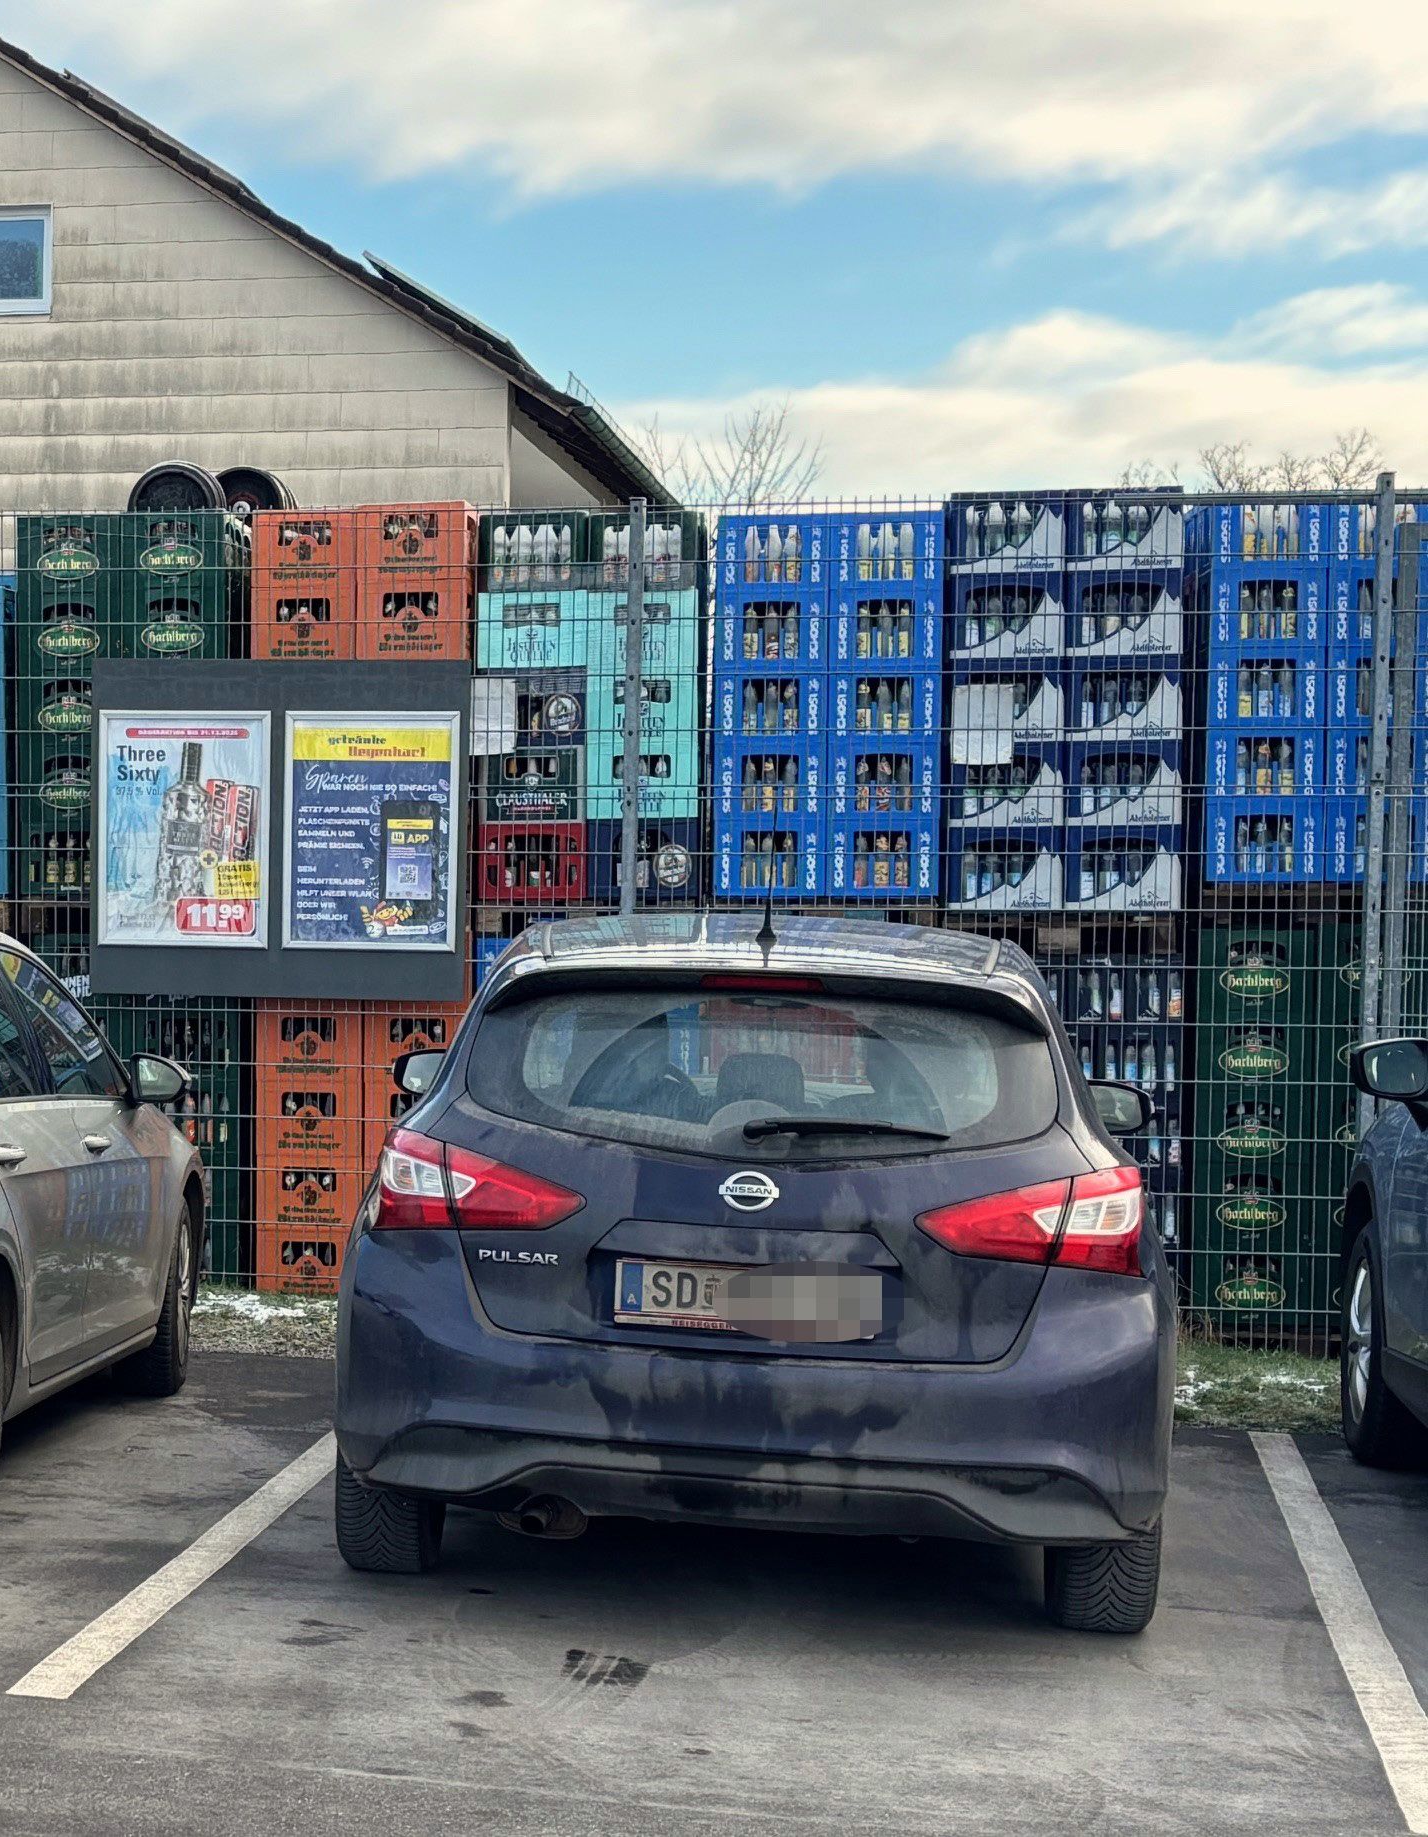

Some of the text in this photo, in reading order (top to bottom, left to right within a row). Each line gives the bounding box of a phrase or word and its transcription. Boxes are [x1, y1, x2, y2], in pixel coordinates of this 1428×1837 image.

[116, 745, 166, 762] Three
[117, 764, 160, 785] Sixty
[305, 764, 367, 794] Sparen
[135, 786, 143, 796] %
[146, 786, 162, 796] Vol.
[399, 784, 437, 792] EINFACH!
[496, 791, 568, 807] CLAUSTHALER
[338, 830, 355, 838] UND
[407, 834, 429, 844] APP
[217, 864, 252, 872] GRATIS
[297, 865, 317, 873] BEIM
[297, 889, 319, 897] HILFT
[296, 901, 319, 909] ODER
[187, 904, 245, 928] 11.99
[1227, 975, 1282, 988] Hacklberg
[1227, 1055, 1281, 1069] Hacklberg
[724, 1184, 772, 1195] NISSAN
[1224, 1207, 1278, 1221] Hacklberg
[479, 1248, 559, 1266] PULSAR
[650, 1270, 698, 1309] SD
[627, 1293, 638, 1305] A
